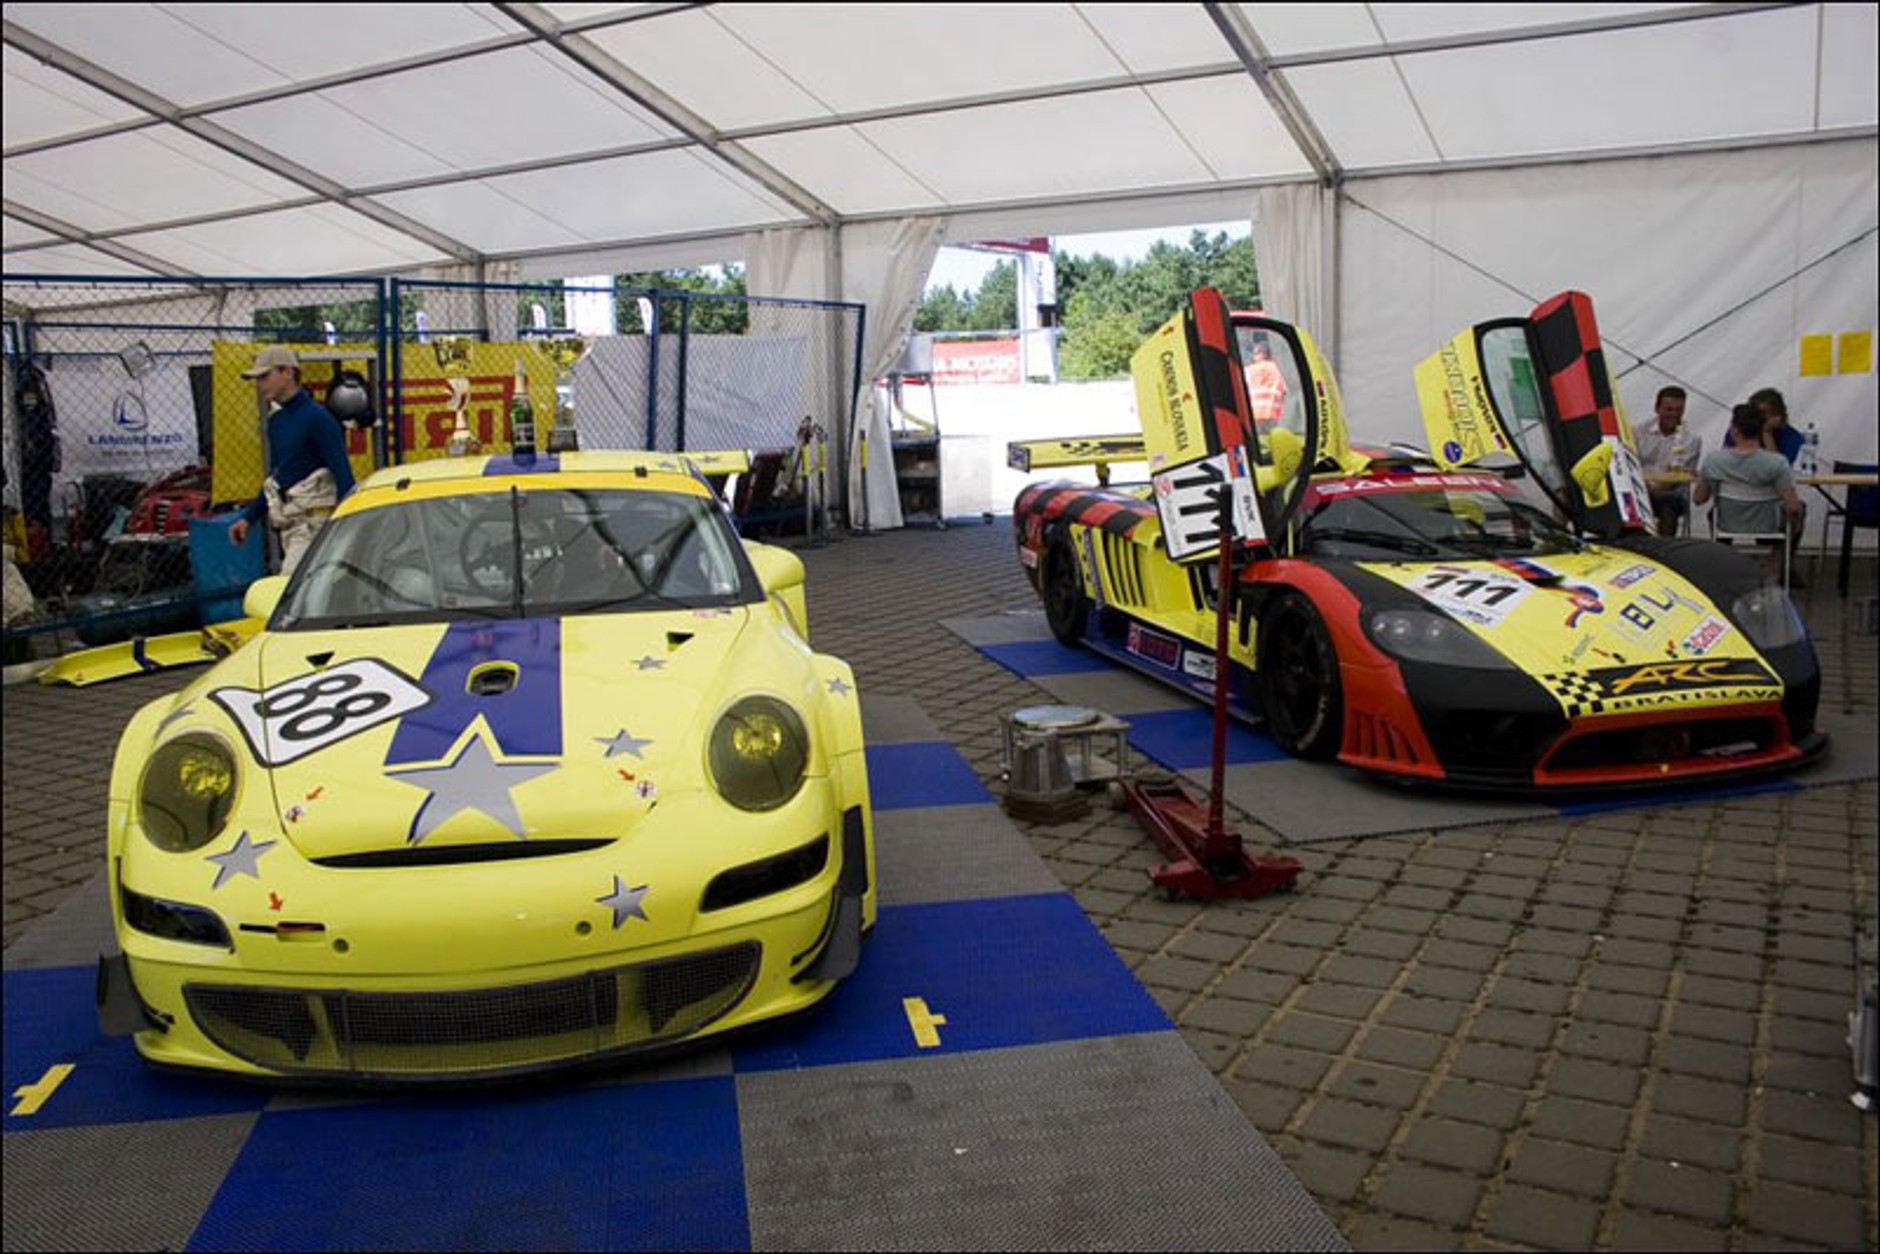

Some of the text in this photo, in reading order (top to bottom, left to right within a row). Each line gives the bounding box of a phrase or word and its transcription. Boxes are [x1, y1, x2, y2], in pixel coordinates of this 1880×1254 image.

[1316, 476, 1505, 495] SALEEN
[1424, 573, 1519, 607] 111
[253, 673, 392, 741] 88
[1613, 689, 1785, 710] BRATISLAVA
